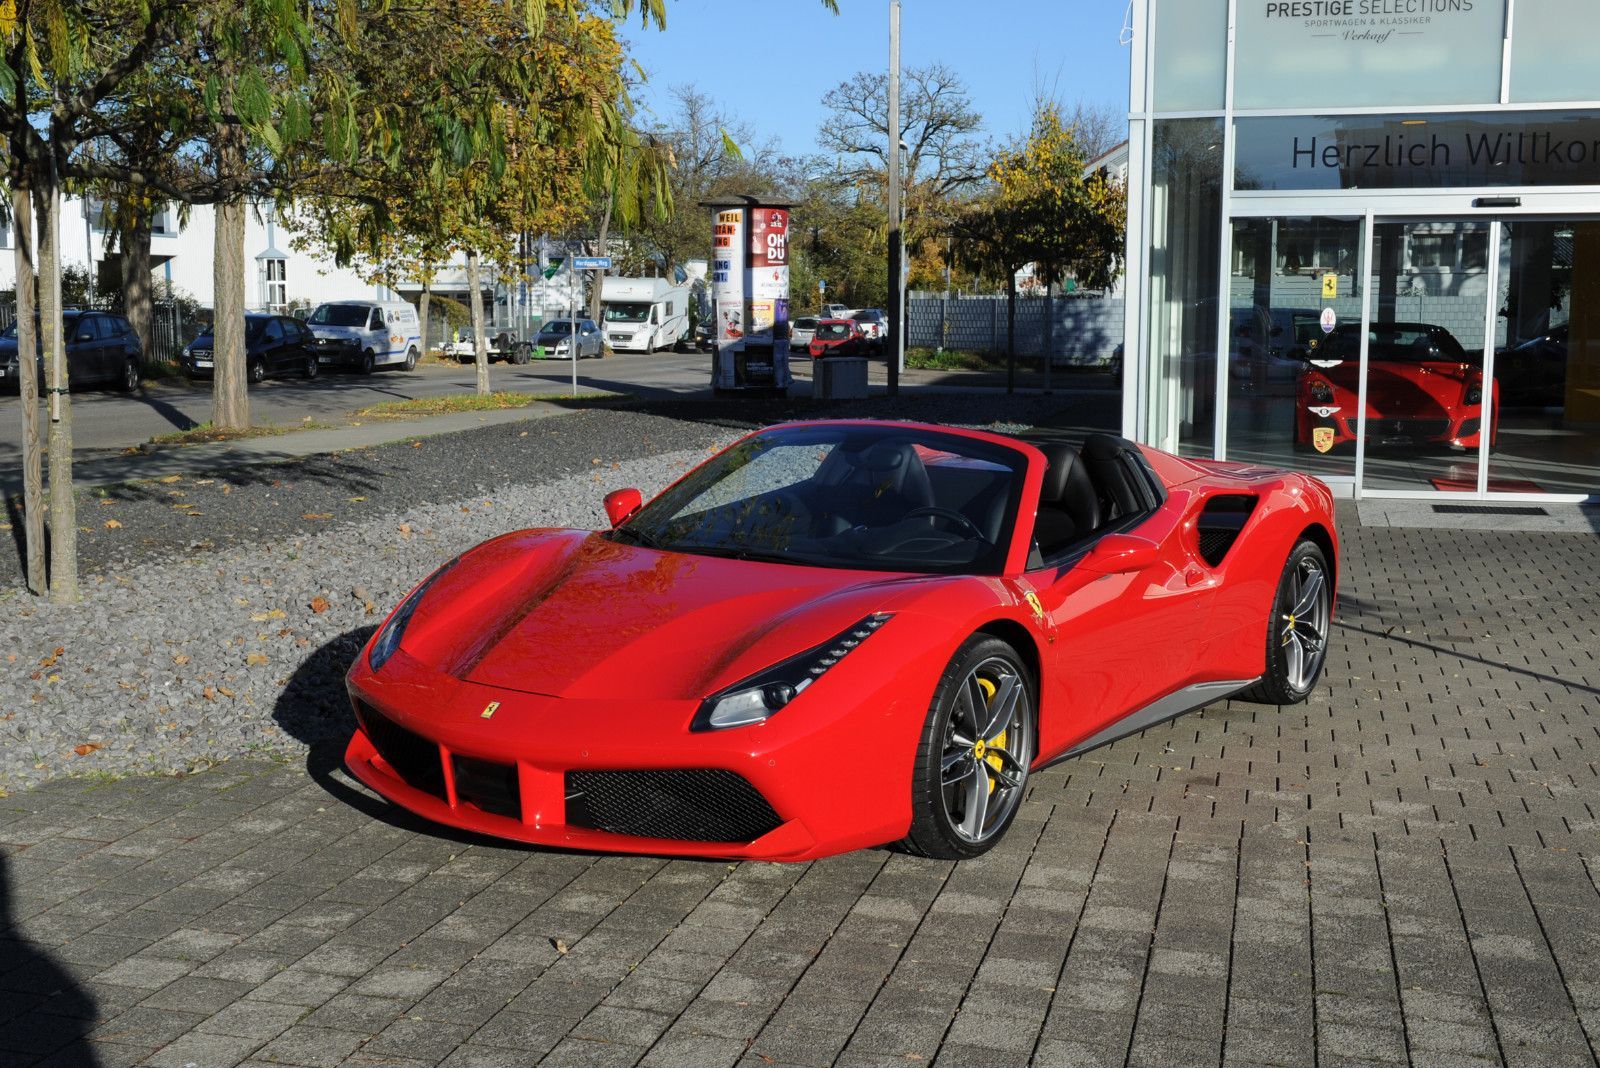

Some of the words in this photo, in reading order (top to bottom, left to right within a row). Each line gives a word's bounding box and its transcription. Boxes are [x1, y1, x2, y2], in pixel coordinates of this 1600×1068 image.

[1266, 0, 1353, 18] PRESTIGE
[1359, 0, 1473, 15] SELECTIONS
[1304, 18, 1367, 28] SPORTWAGEN
[1370, 18, 1376, 26] &
[1379, 16, 1431, 25] KLASSIKER
[1342, 28, 1396, 44] Verkauf
[1292, 134, 1450, 169] Herzlich
[719, 213, 739, 222] WEIL
[767, 233, 785, 247] OH
[767, 247, 785, 260] DU
